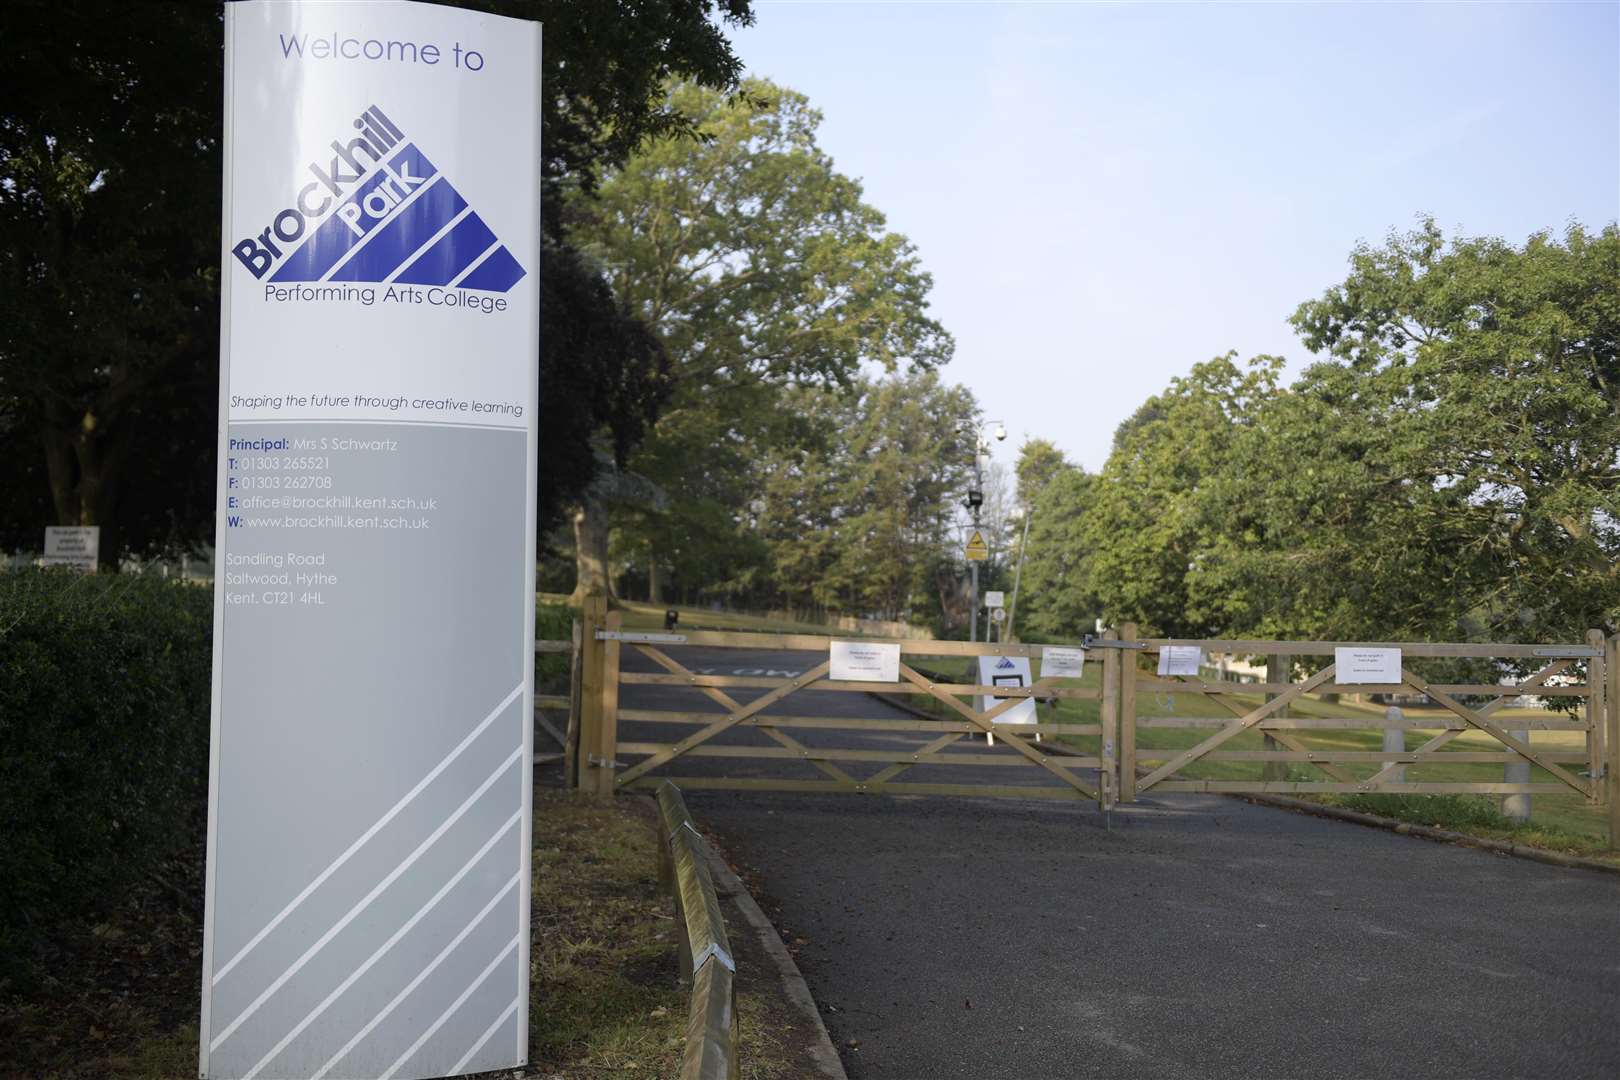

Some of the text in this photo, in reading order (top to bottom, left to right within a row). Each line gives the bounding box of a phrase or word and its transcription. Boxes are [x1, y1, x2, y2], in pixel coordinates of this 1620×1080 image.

[280, 32, 484, 71] Welcome to
[232, 104, 405, 280] Brockhill
[336, 160, 426, 238] Park
[265, 285, 507, 313] Performing Arts College
[231, 394, 523, 418] Shaping the future through creative learning
[229, 438, 398, 453] Principal: Mrs S Schwartz
[229, 457, 329, 470] T: 01303 265521
[229, 476, 332, 489] F: 01303 262708
[228, 495, 437, 510] E: office@brockhill.kent.sch.uk
[227, 515, 430, 529] W: www.brockhill.kent.sch.uk
[226, 552, 325, 568] Sandling Road
[296, 572, 337, 587] Hythe
[262, 591, 294, 605] CT21
[300, 591, 326, 605] 4HL
